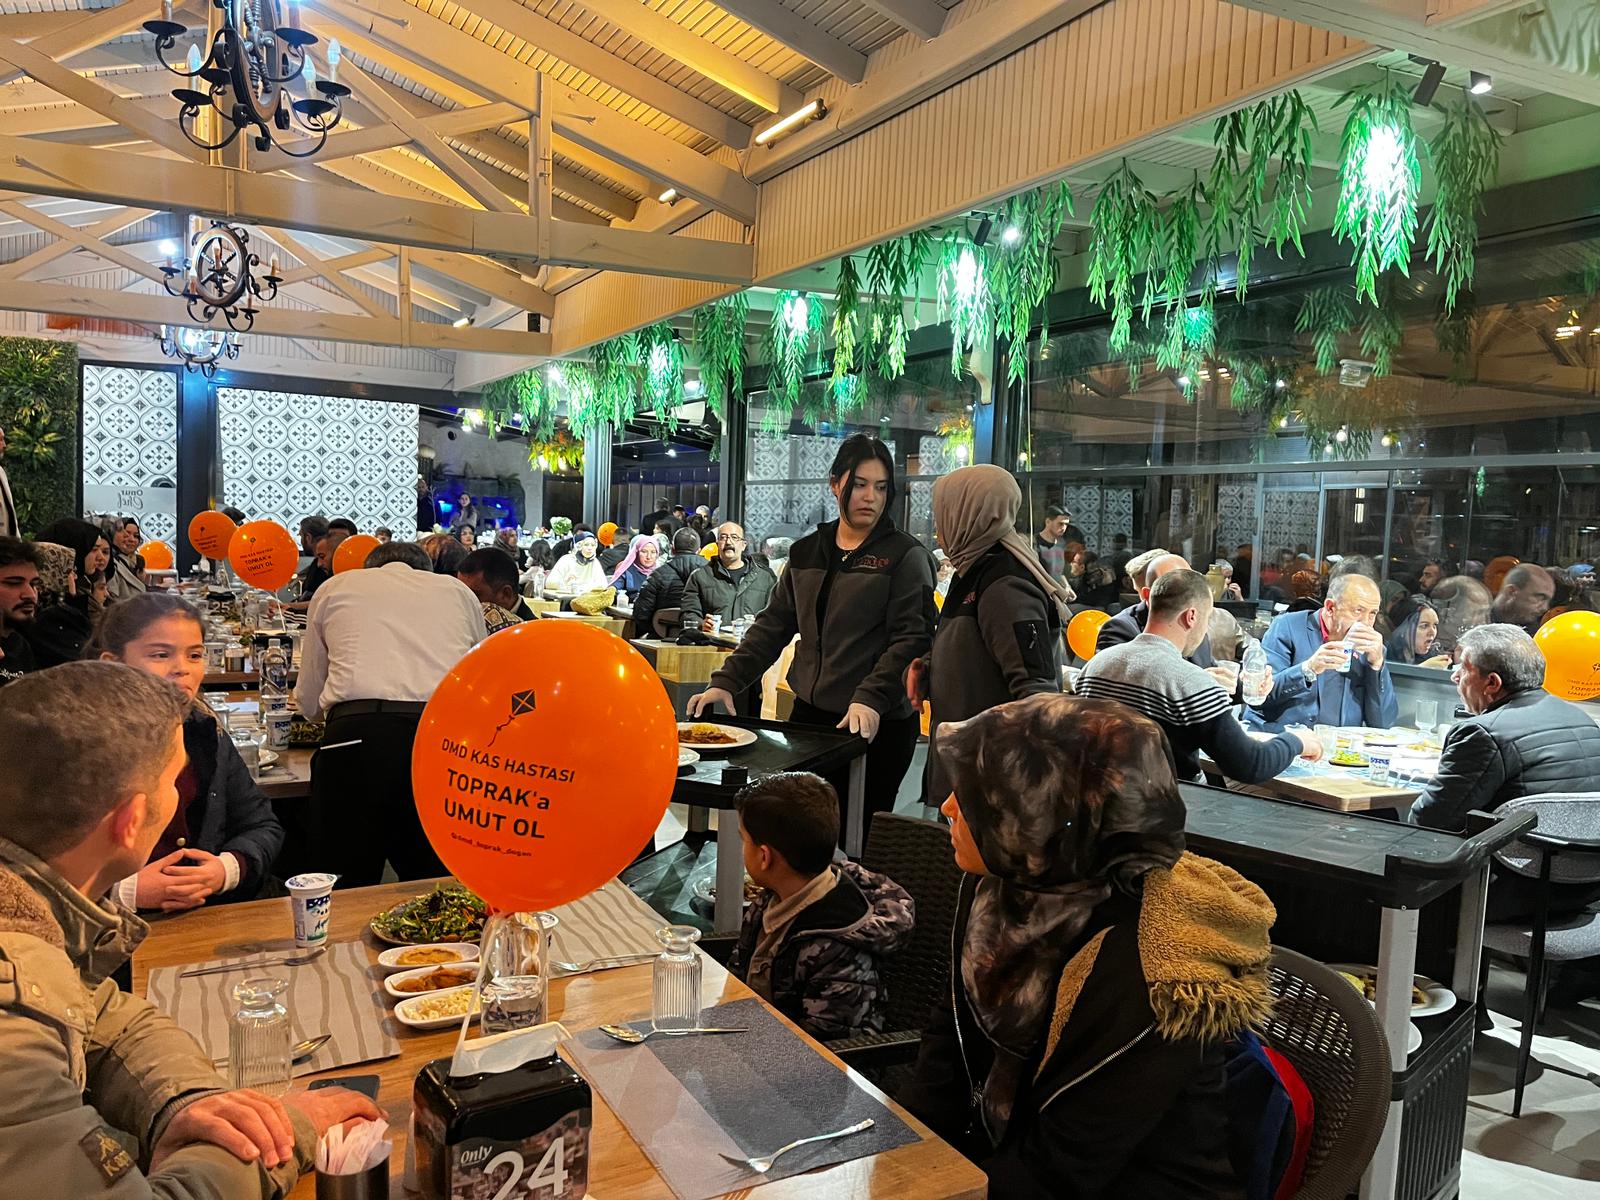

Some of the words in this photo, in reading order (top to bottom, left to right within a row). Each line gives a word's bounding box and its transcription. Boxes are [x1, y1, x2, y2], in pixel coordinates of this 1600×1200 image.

[442, 738, 468, 759] DMD
[471, 749, 501, 768] KAS
[504, 759, 575, 783] HASTASI
[447, 768, 550, 810] TOPRAK'a
[444, 798, 507, 832] UMUT
[513, 818, 545, 839] OL
[460, 1145, 493, 1165] Only
[483, 1136, 569, 1200] 24
